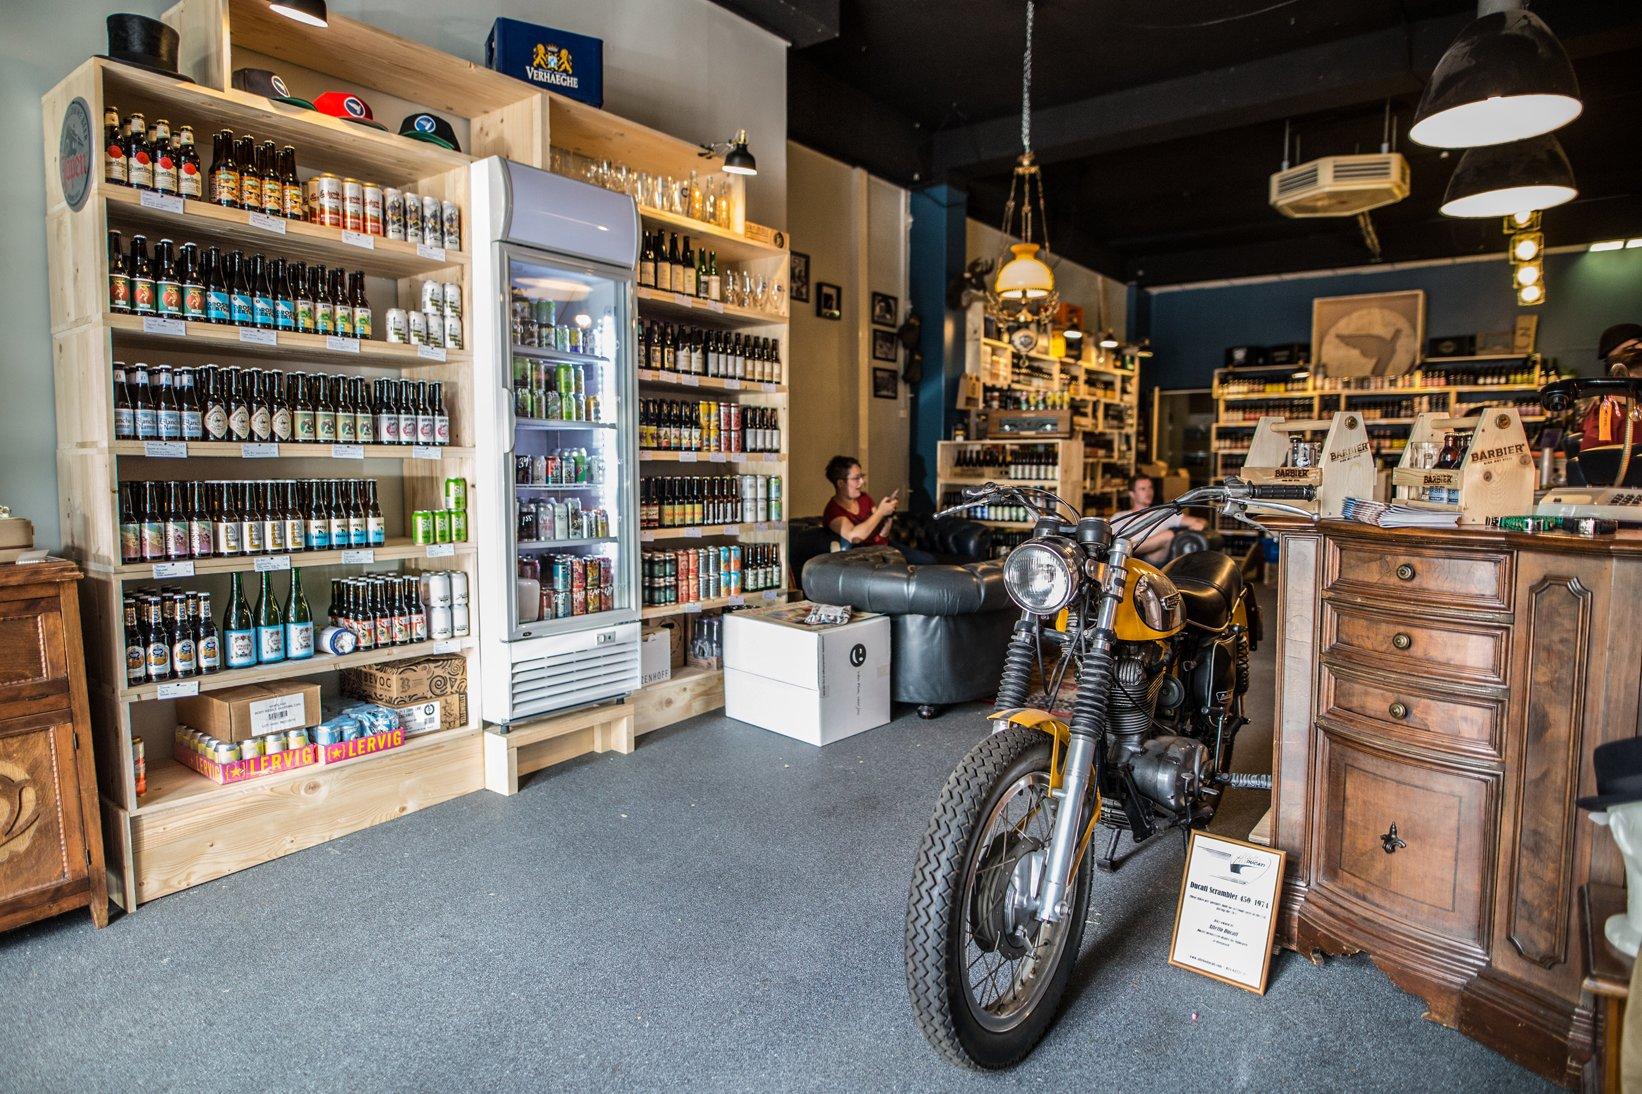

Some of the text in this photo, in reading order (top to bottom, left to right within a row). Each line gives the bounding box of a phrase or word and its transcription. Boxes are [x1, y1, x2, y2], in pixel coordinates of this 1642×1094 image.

[525, 65, 579, 89] VERHAEGHE
[1330, 442, 1368, 461] BARBIER
[1471, 443, 1525, 462] BARBIER
[1275, 469, 1309, 478] BARBIER
[1424, 474, 1453, 484] BARBIER
[348, 730, 402, 758] LERVIG
[249, 746, 313, 776] LERVIG
[1190, 881, 1209, 892] Ducati
[1209, 886, 1238, 900] Scrambler
